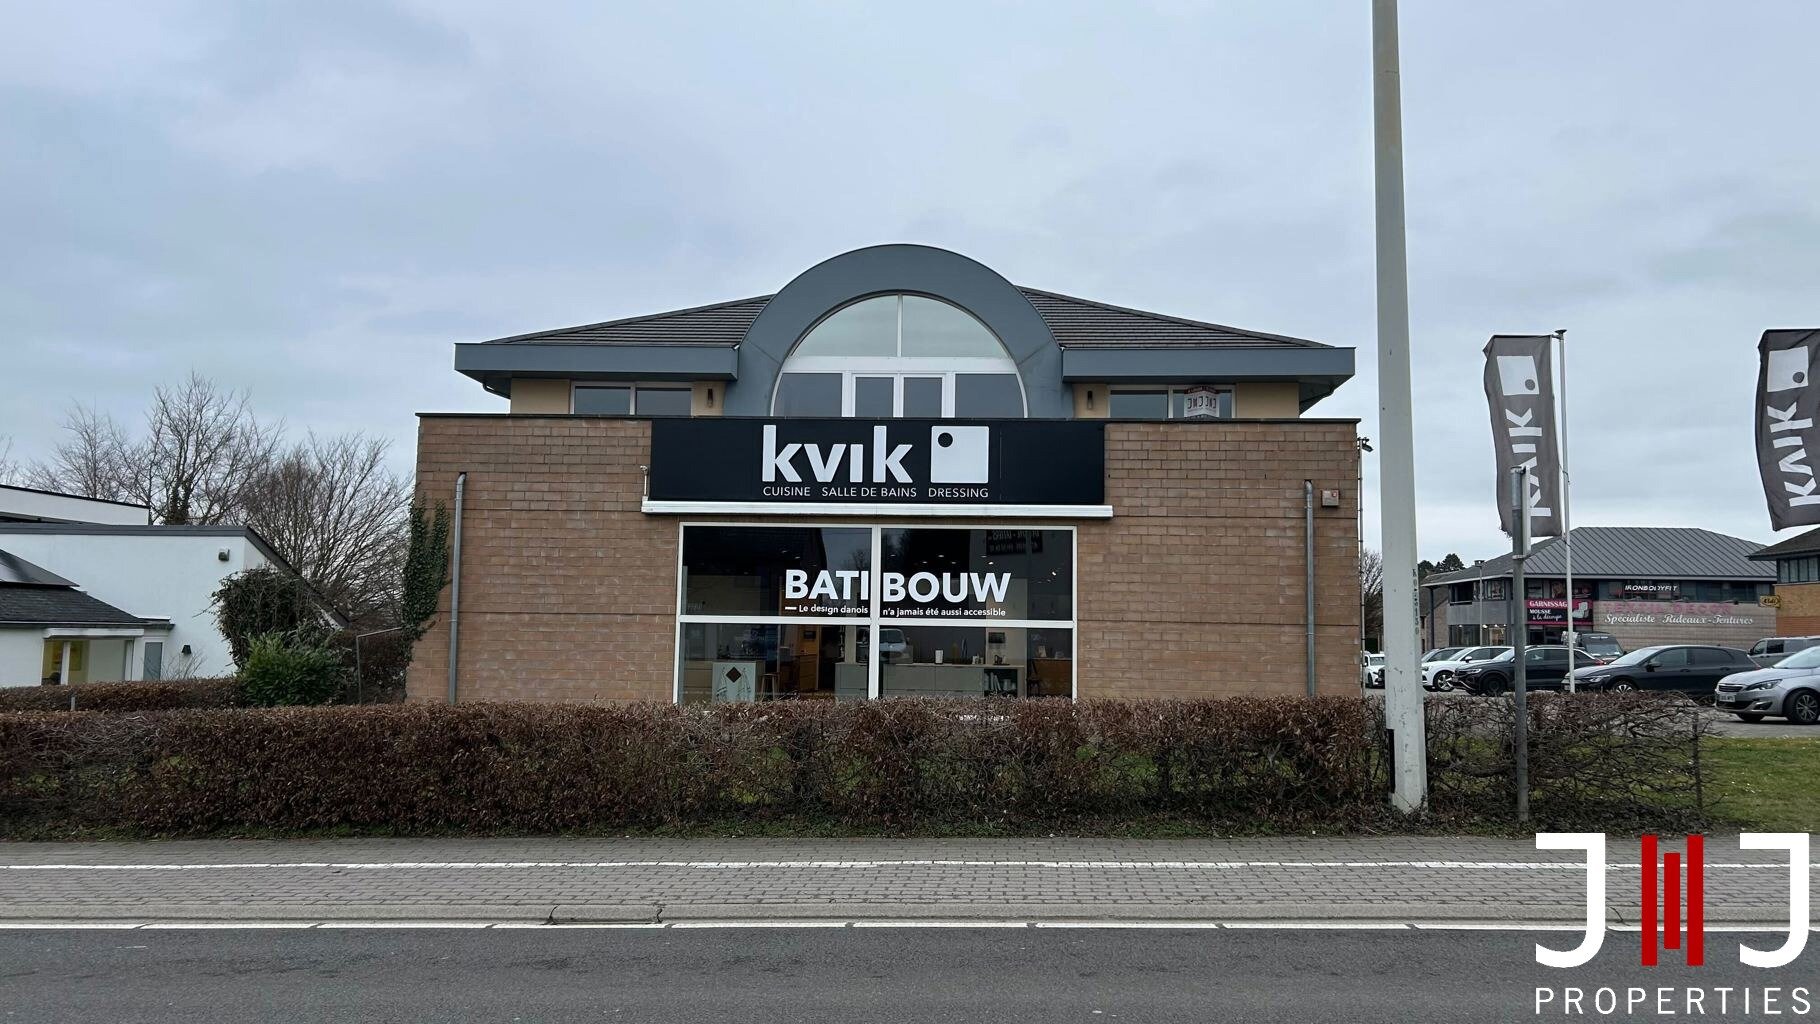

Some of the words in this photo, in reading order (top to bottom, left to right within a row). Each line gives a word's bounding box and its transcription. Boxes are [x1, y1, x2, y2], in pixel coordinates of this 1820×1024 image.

[762, 424, 914, 483] kvik
[763, 486, 811, 497] CUISINE
[822, 487, 857, 497] SALLE
[861, 487, 877, 497] DE
[881, 487, 917, 498] BAINS
[928, 487, 989, 498] DRESSING
[799, 604, 809, 613] Le
[811, 603, 839, 616] design
[840, 604, 869, 614] danois
[896, 607, 924, 618] jamais
[926, 607, 939, 617] été
[940, 608, 962, 617] aussi
[963, 607, 1006, 618] accessible
[1529, 600, 1567, 608] GARNISSAG
